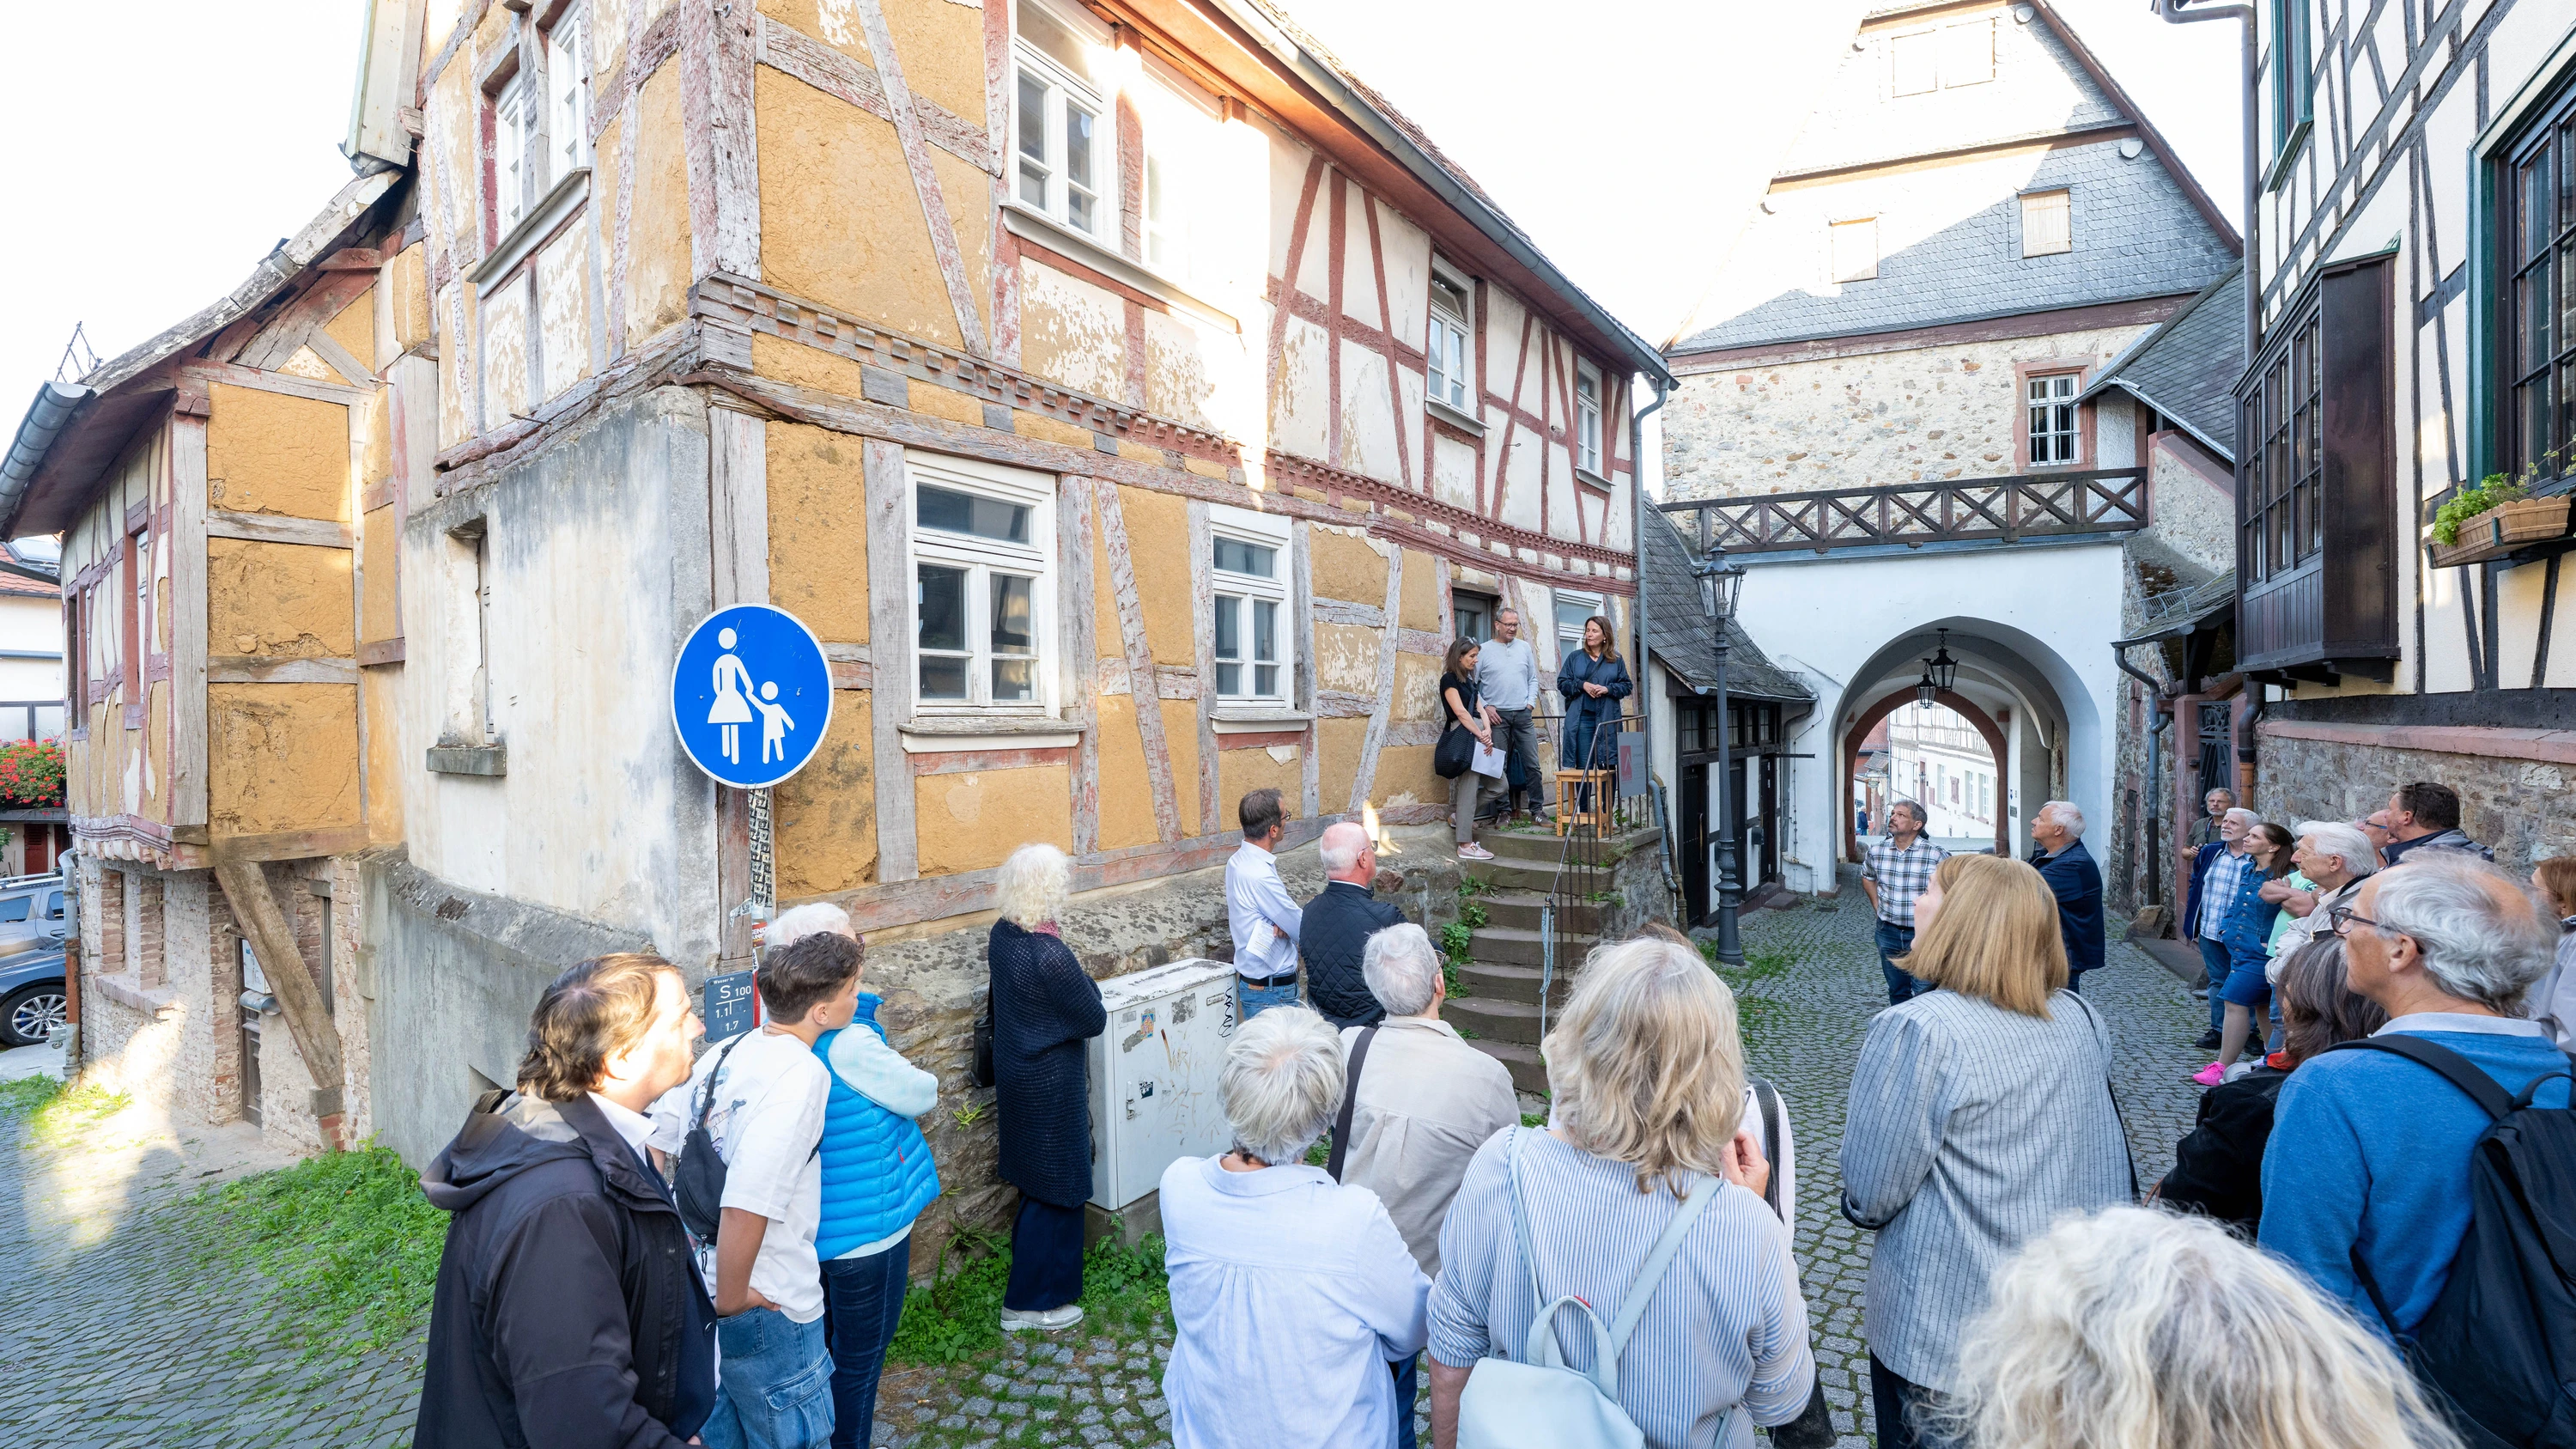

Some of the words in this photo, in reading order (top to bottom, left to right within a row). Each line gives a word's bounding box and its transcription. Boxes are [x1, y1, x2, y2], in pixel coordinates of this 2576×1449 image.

[720, 984, 731, 999] S
[735, 985, 751, 997] 100
[726, 1020, 738, 1032] 1.7
